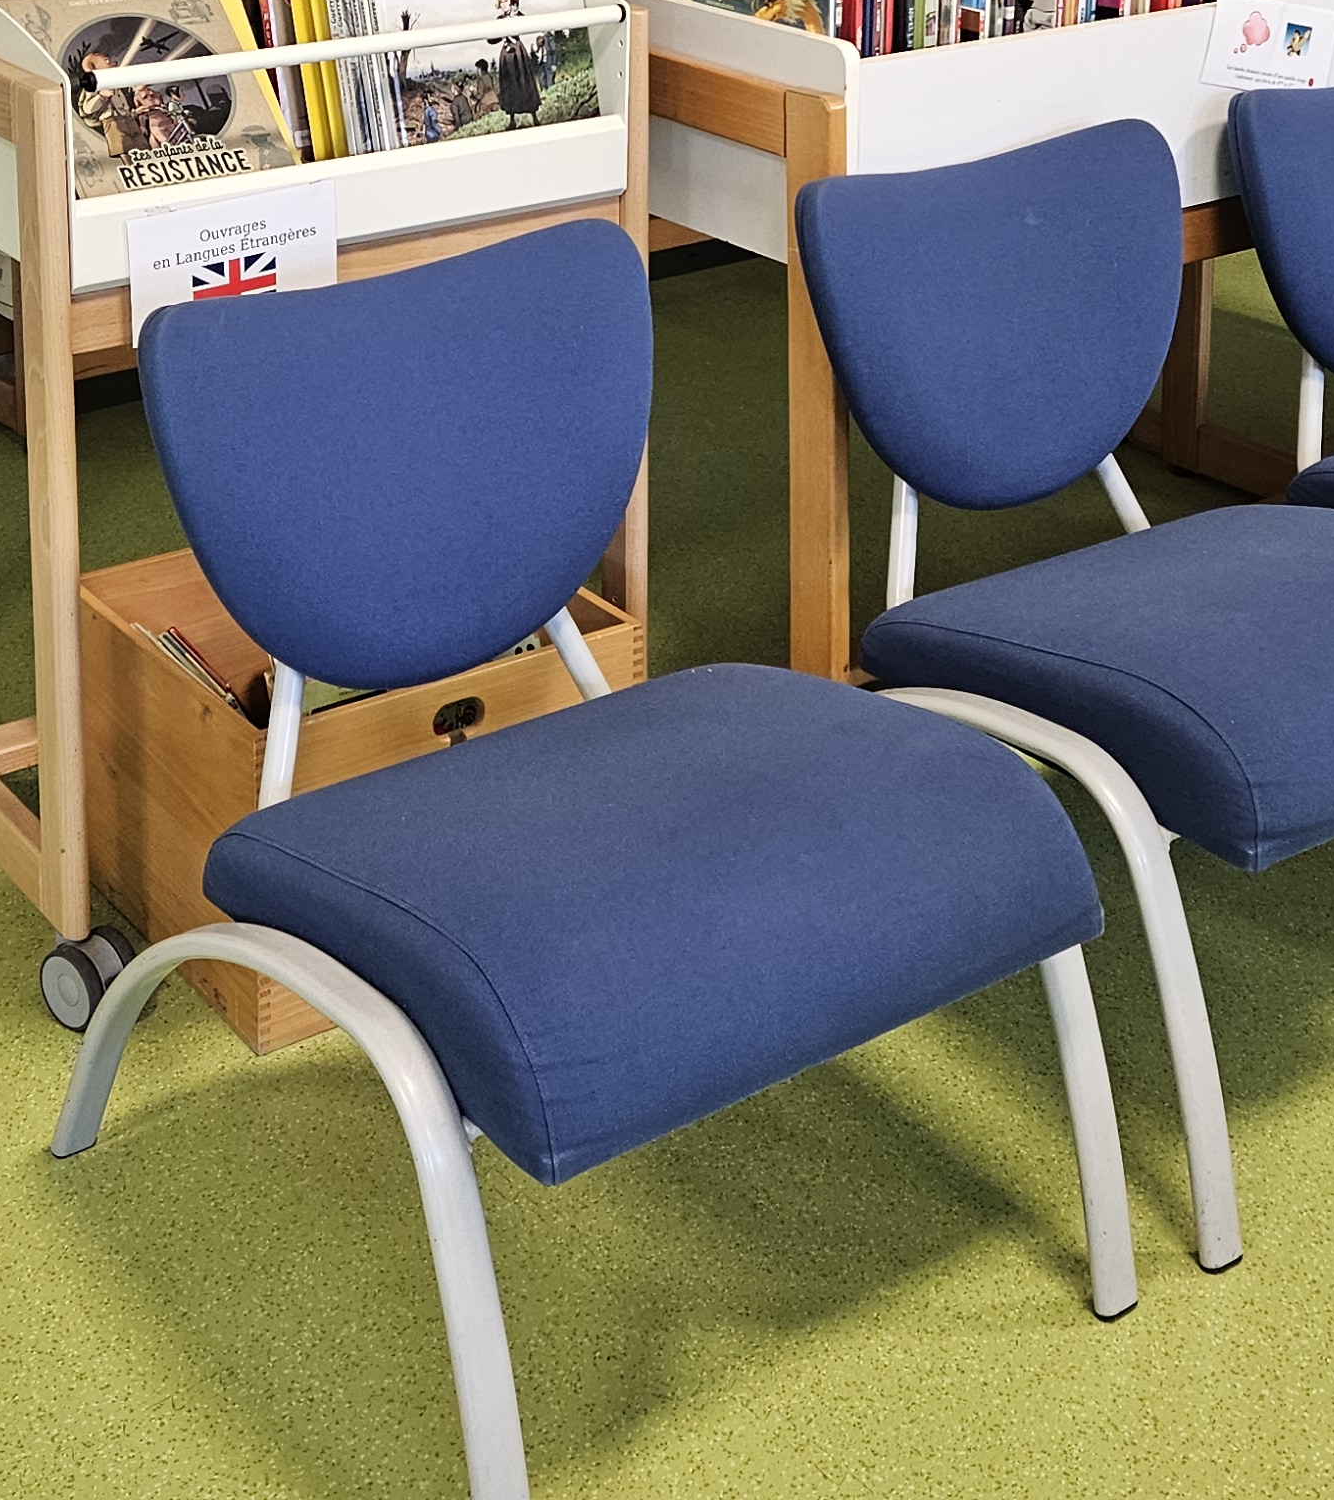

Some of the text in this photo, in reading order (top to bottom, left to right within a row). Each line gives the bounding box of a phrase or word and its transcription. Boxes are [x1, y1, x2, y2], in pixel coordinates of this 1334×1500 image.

[131, 136, 224, 162] Les enfants de la
[119, 150, 252, 189] RÉSISTANCE
[199, 219, 267, 242] Ouvrages
[153, 225, 317, 271] en Langues Étrangères
